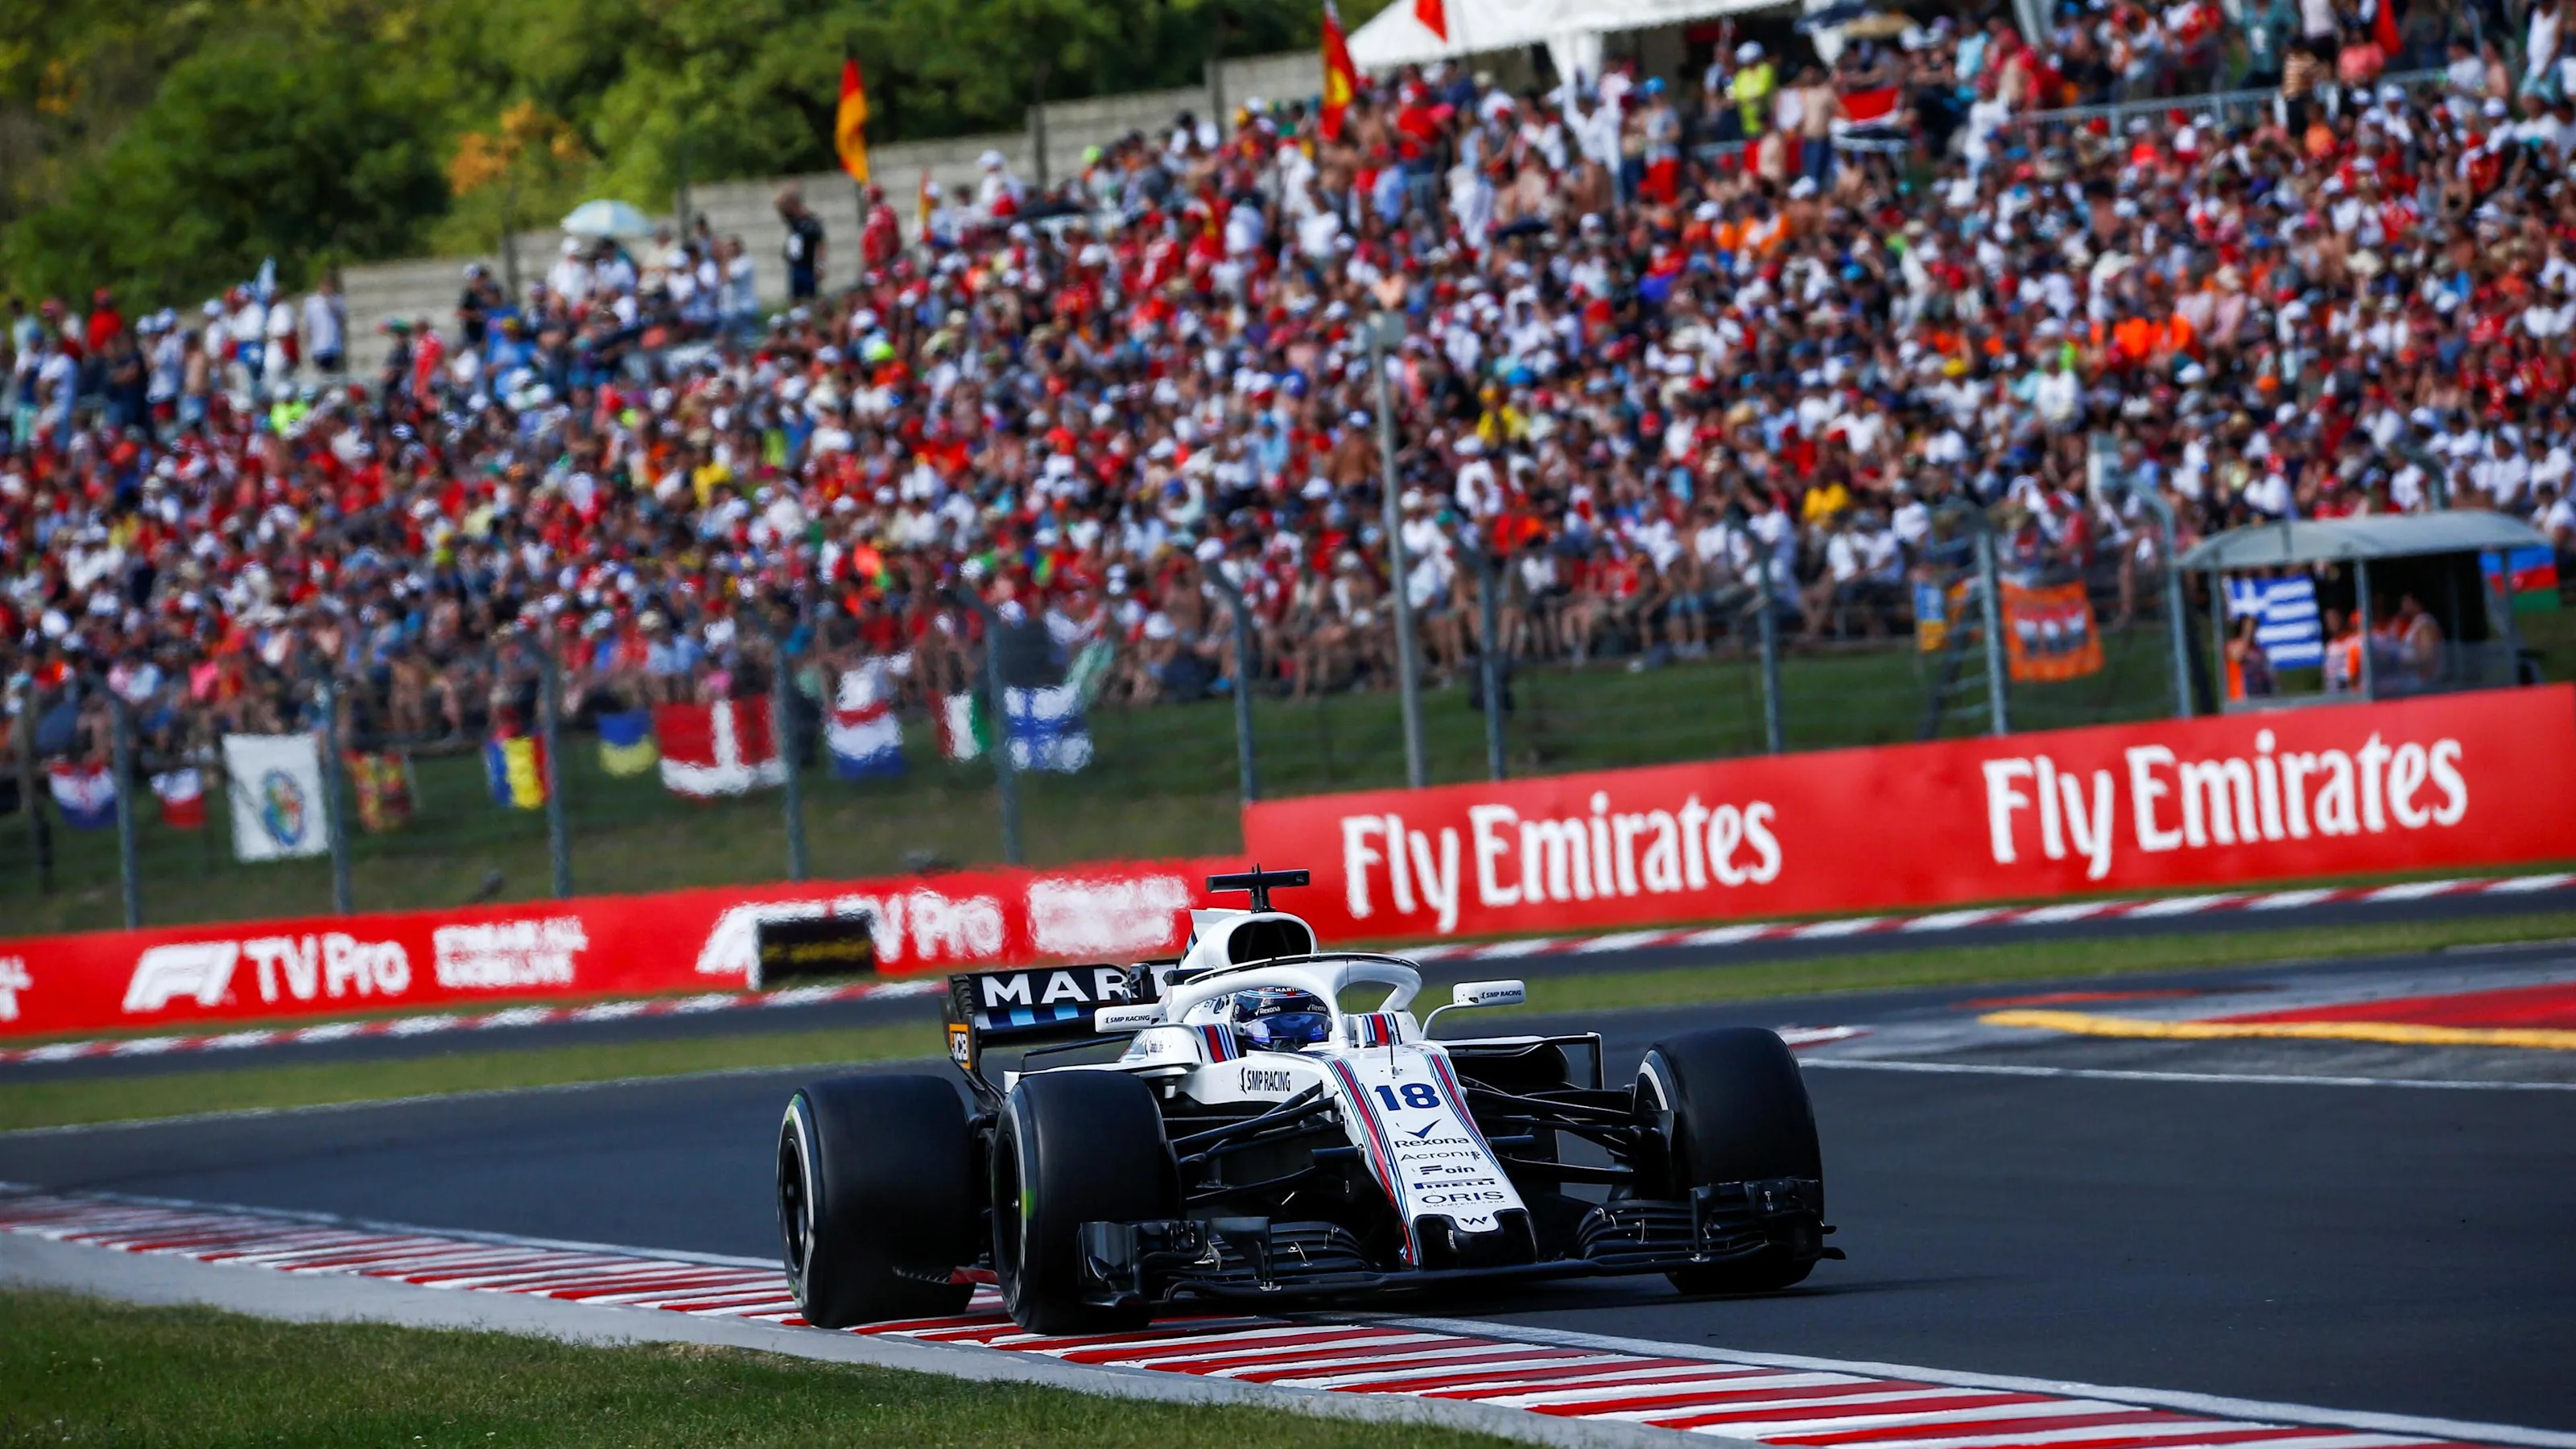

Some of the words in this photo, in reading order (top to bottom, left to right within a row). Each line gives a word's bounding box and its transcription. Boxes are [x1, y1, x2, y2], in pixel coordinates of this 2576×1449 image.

[1983, 754, 2113, 879] Fly
[2125, 728, 2468, 853] Emirates
[1341, 813, 1459, 932] Fly
[1469, 791, 1781, 907] Emirates
[909, 888, 1003, 961] Pro
[242, 935, 319, 1002] TV
[322, 931, 412, 997] Pro
[1260, 1006, 1281, 1014] Rexona
[952, 1032, 968, 1060] JCB
[1248, 1071, 1262, 1090] SMP
[1264, 1071, 1290, 1092] RACING
[1374, 1083, 1441, 1111] 18
[1393, 1137, 1469, 1148] Rexona
[1401, 1151, 1480, 1161] Acronis
[1413, 1178, 1496, 1190] PIRELLI
[1422, 1191, 1505, 1203] ORIS
